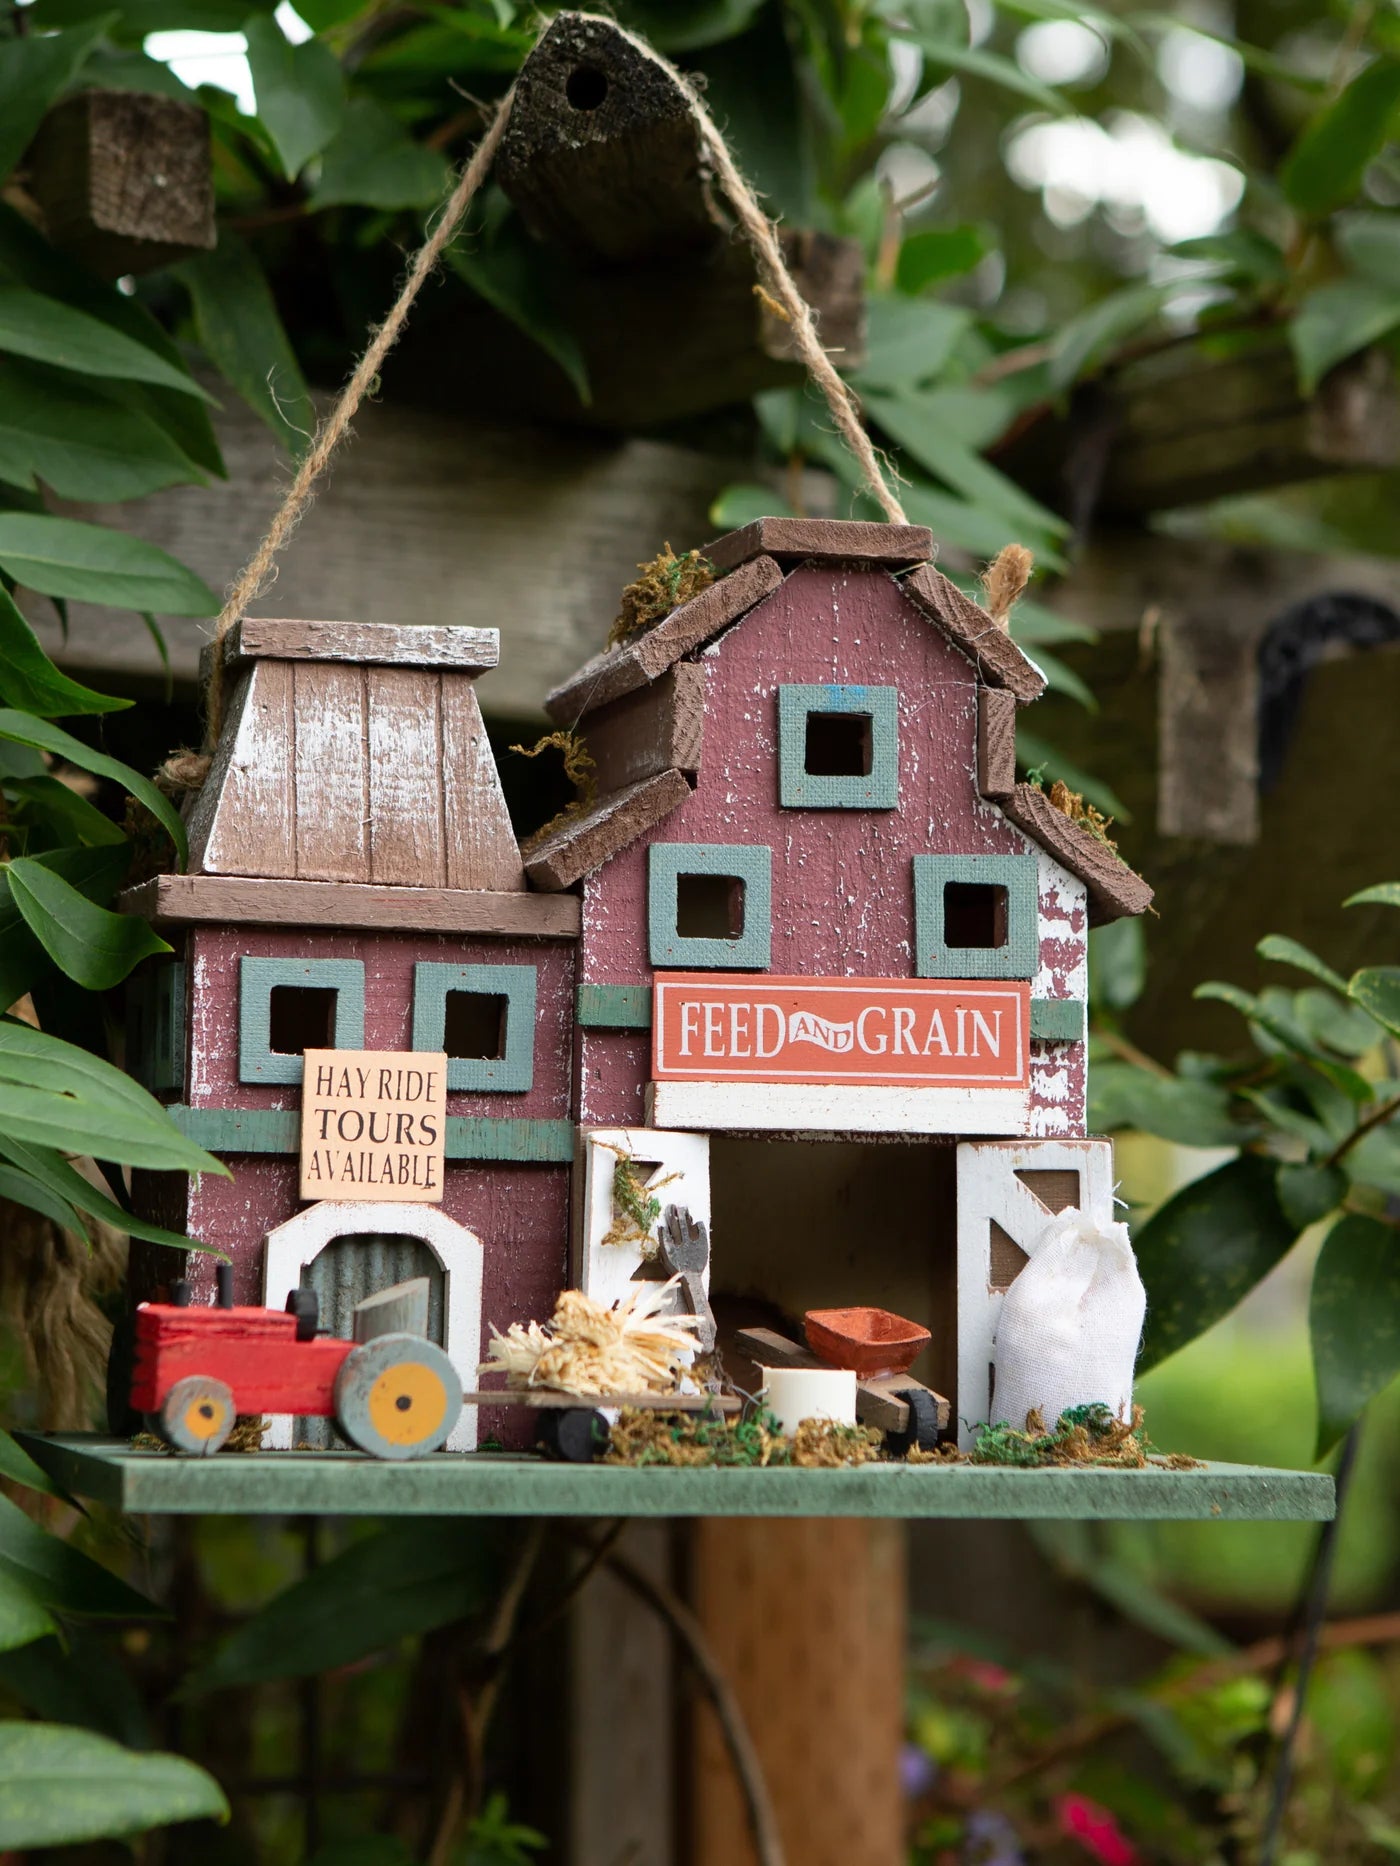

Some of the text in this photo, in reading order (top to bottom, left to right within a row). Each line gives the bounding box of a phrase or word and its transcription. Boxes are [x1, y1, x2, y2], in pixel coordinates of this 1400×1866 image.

[678, 1001, 1003, 1058] FEED AND GRAIN
[314, 1108, 437, 1146] TOURS
[307, 1149, 437, 1188] AVAILABLE
